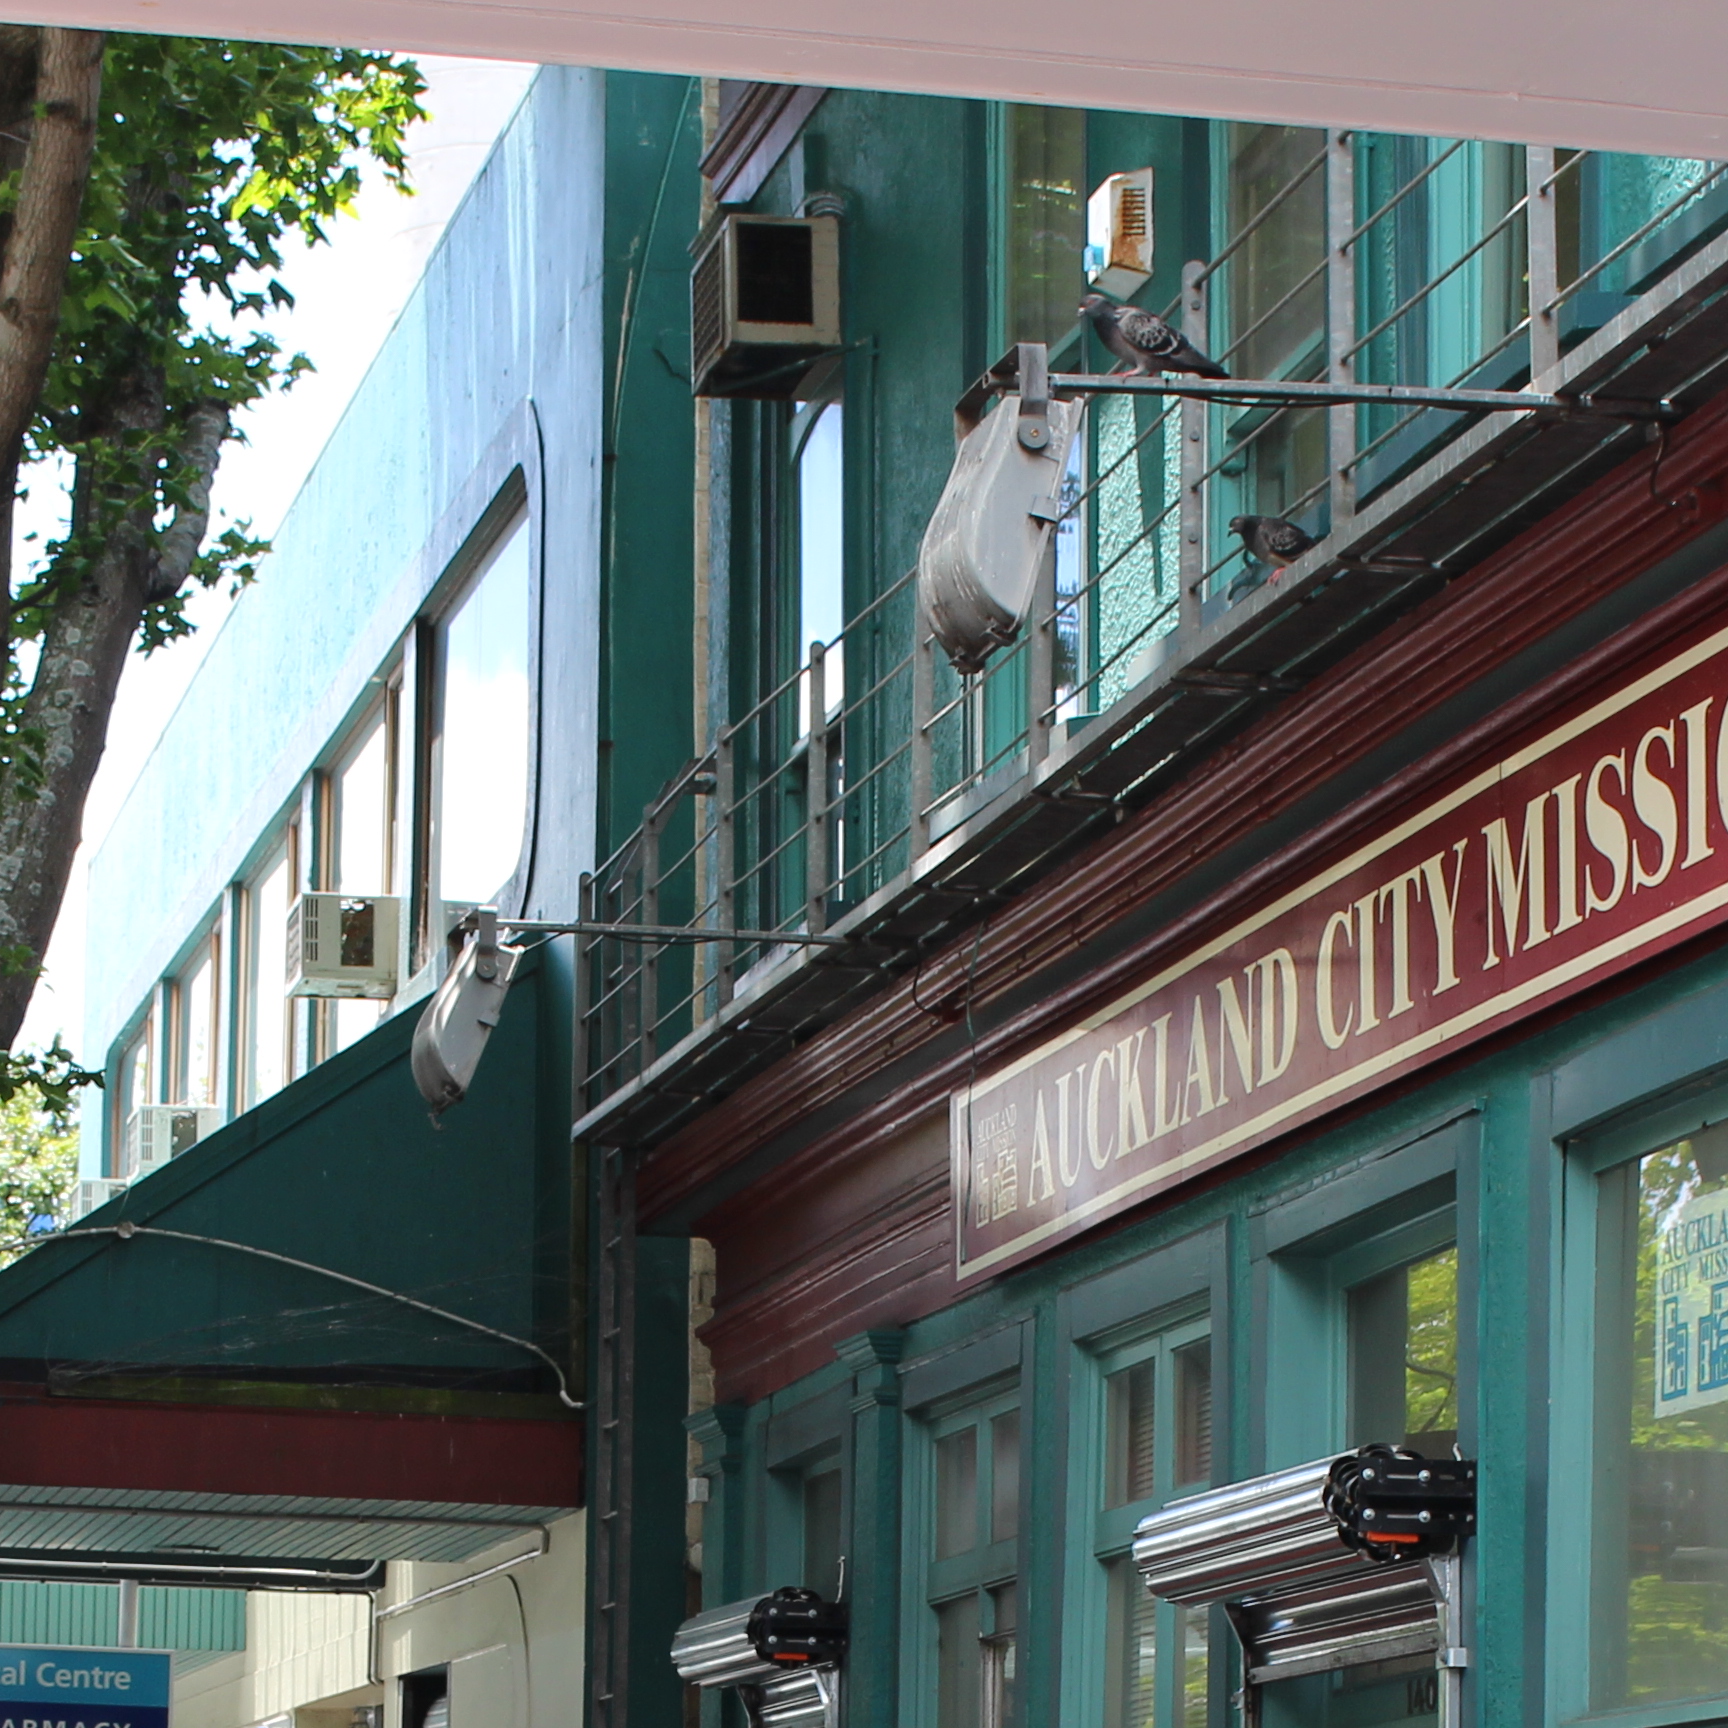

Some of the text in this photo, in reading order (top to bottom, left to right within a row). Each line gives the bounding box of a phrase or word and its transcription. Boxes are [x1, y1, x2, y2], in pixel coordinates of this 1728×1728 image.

[1024, 944, 1300, 1209] AUCKLAND
[1314, 838, 1469, 1053] CITY
[1661, 1261, 1692, 1296] CITY
[35, 1663, 132, 1691] Centre
